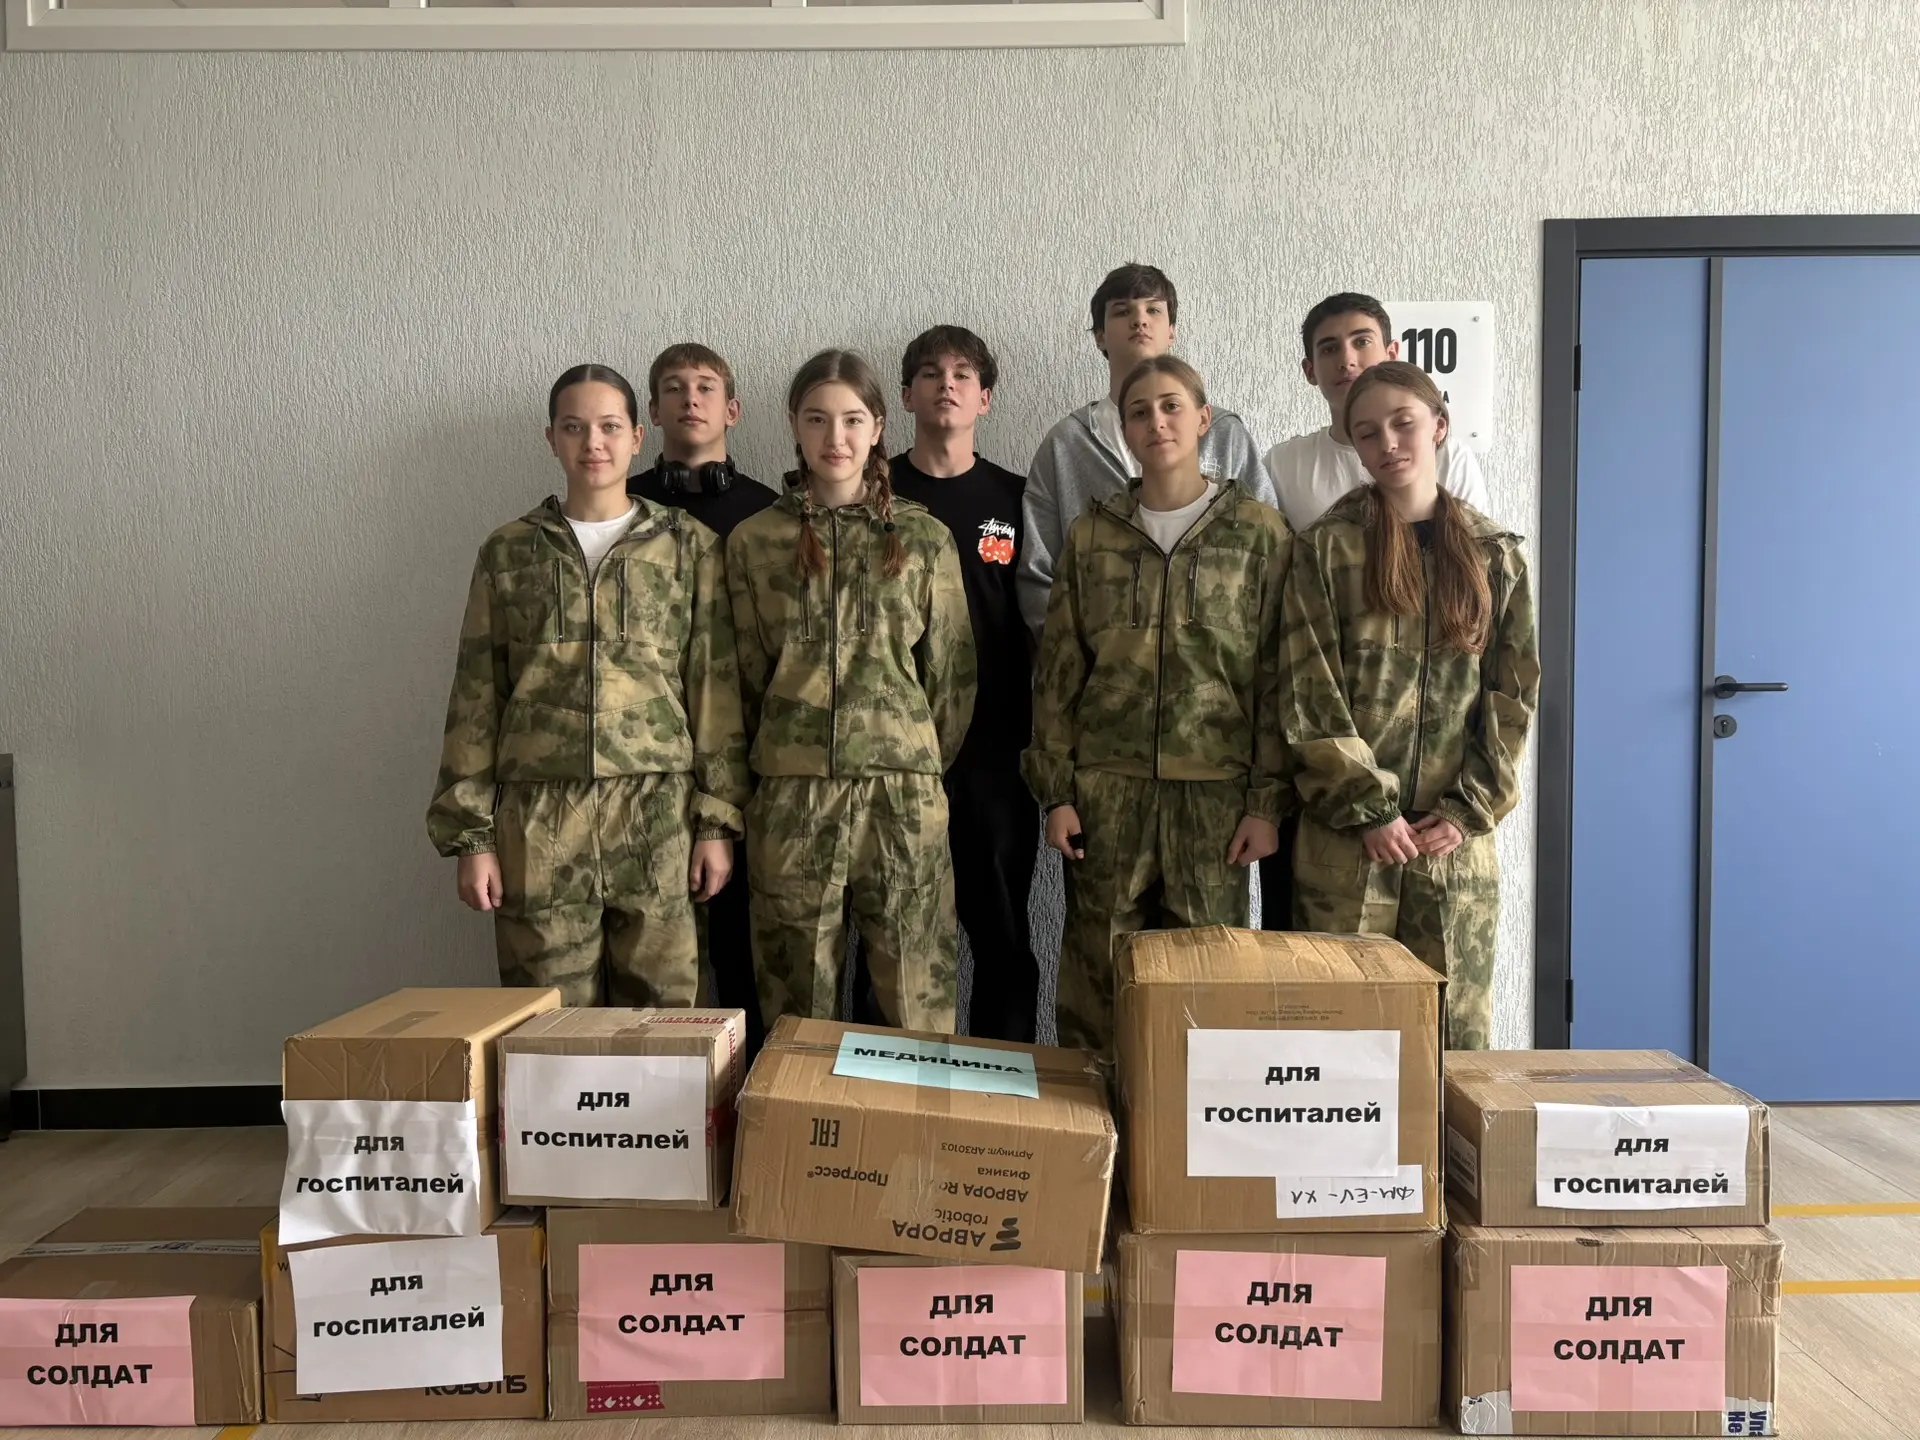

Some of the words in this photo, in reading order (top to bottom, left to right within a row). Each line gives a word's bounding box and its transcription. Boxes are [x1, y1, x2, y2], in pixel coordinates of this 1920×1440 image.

[1402, 328, 1457, 374] 110
[853, 1047, 1024, 1074] МЕДИЦИНА
[1265, 1066, 1320, 1086] для
[577, 1091, 630, 1112] для
[1204, 1101, 1381, 1123] госпиталей
[353, 1135, 405, 1155] для
[521, 1129, 689, 1150] госпиталей
[1614, 1138, 1670, 1157] для
[988, 1147, 1034, 1160] Артикул:
[296, 1172, 464, 1194] госпиталей
[977, 1166, 1031, 1181] Физика
[1554, 1172, 1729, 1194] госпиталей
[963, 1183, 1029, 1203] АВРОРА
[932, 1208, 989, 1226] robotic
[892, 1219, 986, 1248] АВРОРА
[370, 1274, 424, 1297] для
[649, 1273, 714, 1296] ДЛЯ
[1246, 1281, 1313, 1306] ДЛЯ
[929, 1294, 994, 1320] ДЛЯ
[1585, 1296, 1652, 1321] ДЛЯ
[313, 1305, 485, 1338] госпиталей
[618, 1314, 746, 1336] СОЛДАТ
[54, 1322, 118, 1348] ДЛЯ
[1214, 1322, 1344, 1351] СОЛДАТ
[899, 1334, 1027, 1360] СОЛДАТ
[1553, 1339, 1686, 1365] СОЛДАТ
[27, 1364, 153, 1389] СОЛДАТ
[1728, 1411, 1746, 1433] Не
